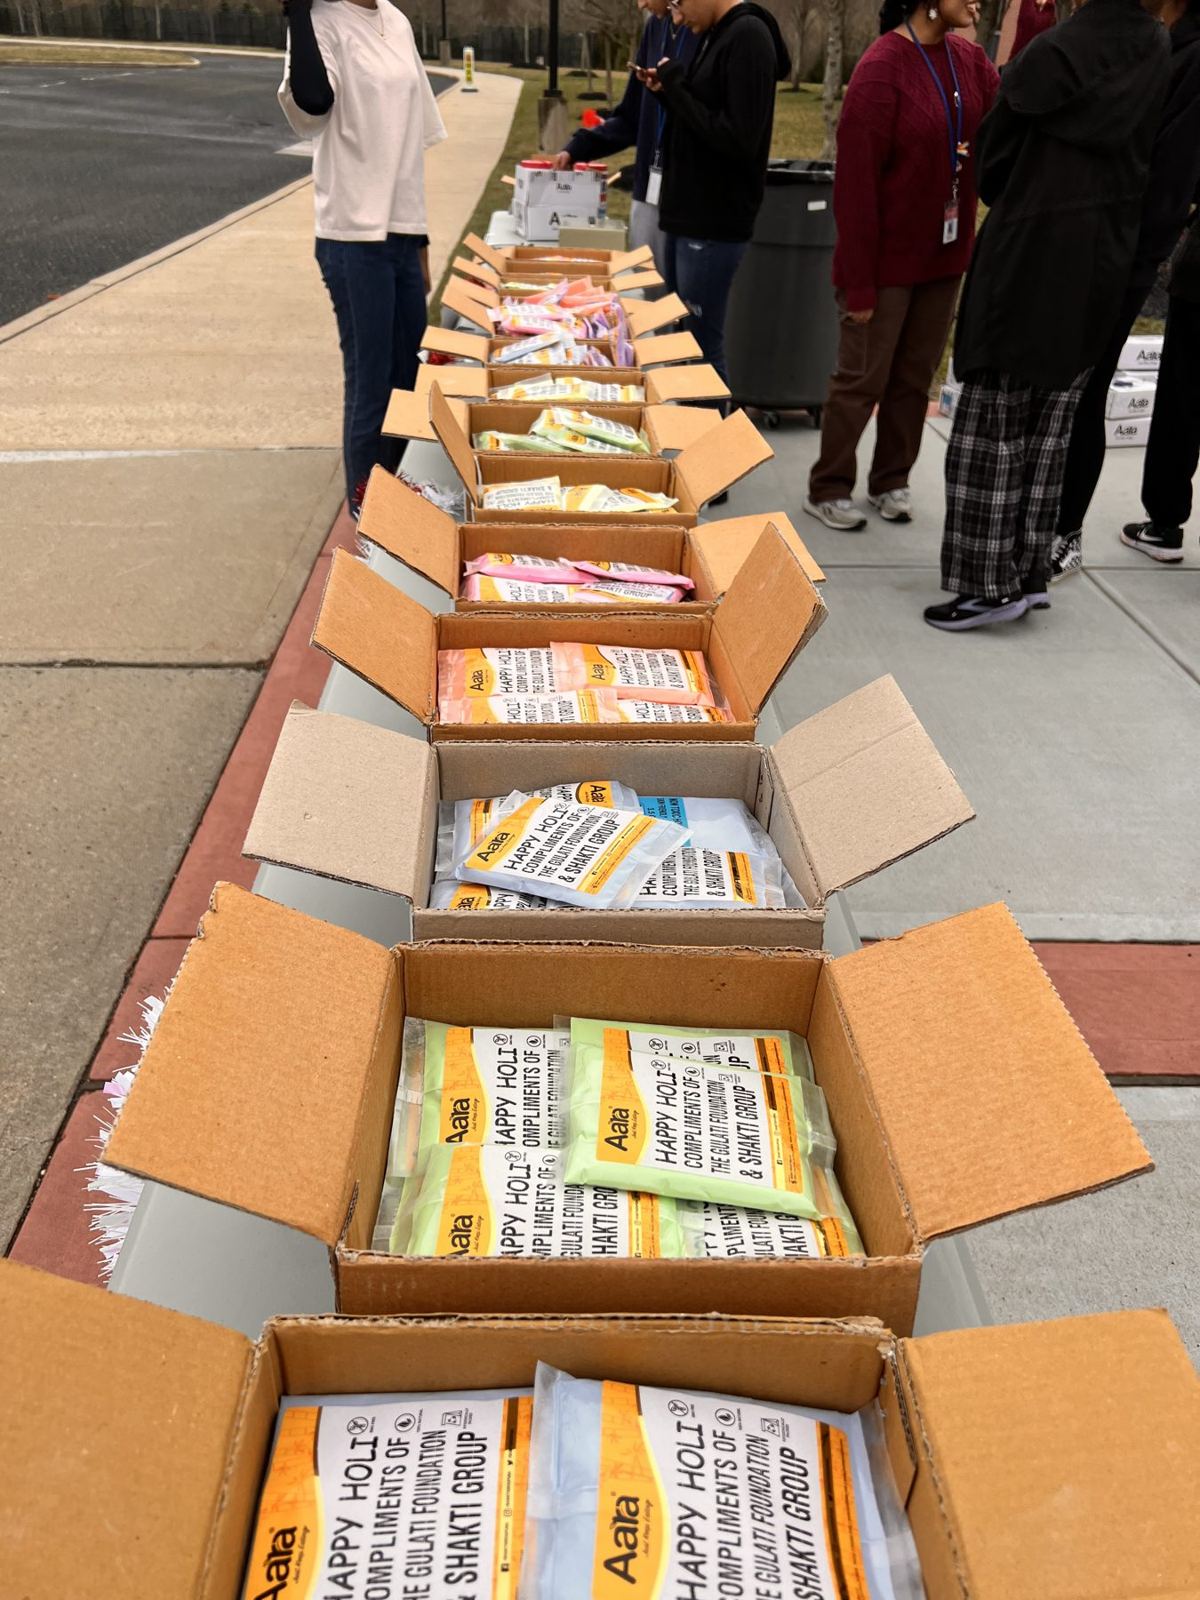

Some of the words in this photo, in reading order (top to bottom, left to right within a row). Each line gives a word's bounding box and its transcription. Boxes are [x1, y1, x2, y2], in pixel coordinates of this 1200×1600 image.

[499, 667, 513, 693] HAPPY
[477, 832, 510, 862] Aara
[504, 834, 541, 870] HAPPY
[534, 807, 569, 833] HOLI
[522, 822, 574, 874] COMPLIMENTS
[567, 810, 582, 822] OF
[588, 819, 621, 845] GROUP
[538, 865, 558, 878] THE
[558, 875, 577, 883] &
[564, 845, 600, 875] SHAKTI
[683, 885, 699, 896] THE
[496, 1048, 518, 1088] HOLI
[523, 1050, 541, 1064] OF
[656, 1070, 677, 1107] HOLI
[683, 1076, 700, 1089] OF
[707, 1079, 728, 1124] FOUNDATION
[733, 1085, 758, 1120] GROUP
[522, 1067, 541, 1147] OMPLIMENTS
[604, 1107, 630, 1151] Aara
[655, 1111, 677, 1164] HAPPY
[683, 1090, 703, 1169] COMPLIMENTS
[710, 1125, 730, 1155] GULATI
[736, 1122, 762, 1166] SHAKTI
[505, 1163, 531, 1205] HOLI
[537, 1166, 556, 1179] OF
[711, 1156, 731, 1174] THE
[739, 1169, 763, 1180] &
[532, 1182, 556, 1256] MPLIMENTS
[562, 1184, 585, 1218] FOUNDA
[592, 1186, 618, 1210] GRO
[591, 1213, 618, 1255] HAKTI
[717, 1206, 746, 1256] PLIMENT
[385, 1437, 410, 1459] OF
[451, 1431, 488, 1495] GROUP
[676, 1420, 706, 1491] HOLI
[713, 1430, 736, 1453] OF
[339, 1436, 378, 1500] HOLI
[411, 1430, 447, 1515] FOUNDATION
[745, 1433, 770, 1526] FOUNDATION
[780, 1447, 809, 1521] GROUP
[364, 1465, 407, 1600] OMPLIMENTS
[404, 1519, 437, 1578] GULATI
[443, 1503, 483, 1585] SHAKTI
[603, 1494, 640, 1585] Aara
[676, 1502, 708, 1600] HAPPY
[713, 1458, 744, 1600] OMPLIMENTS
[752, 1526, 782, 1584] GULATI
[785, 1524, 824, 1600] SHAKTI
